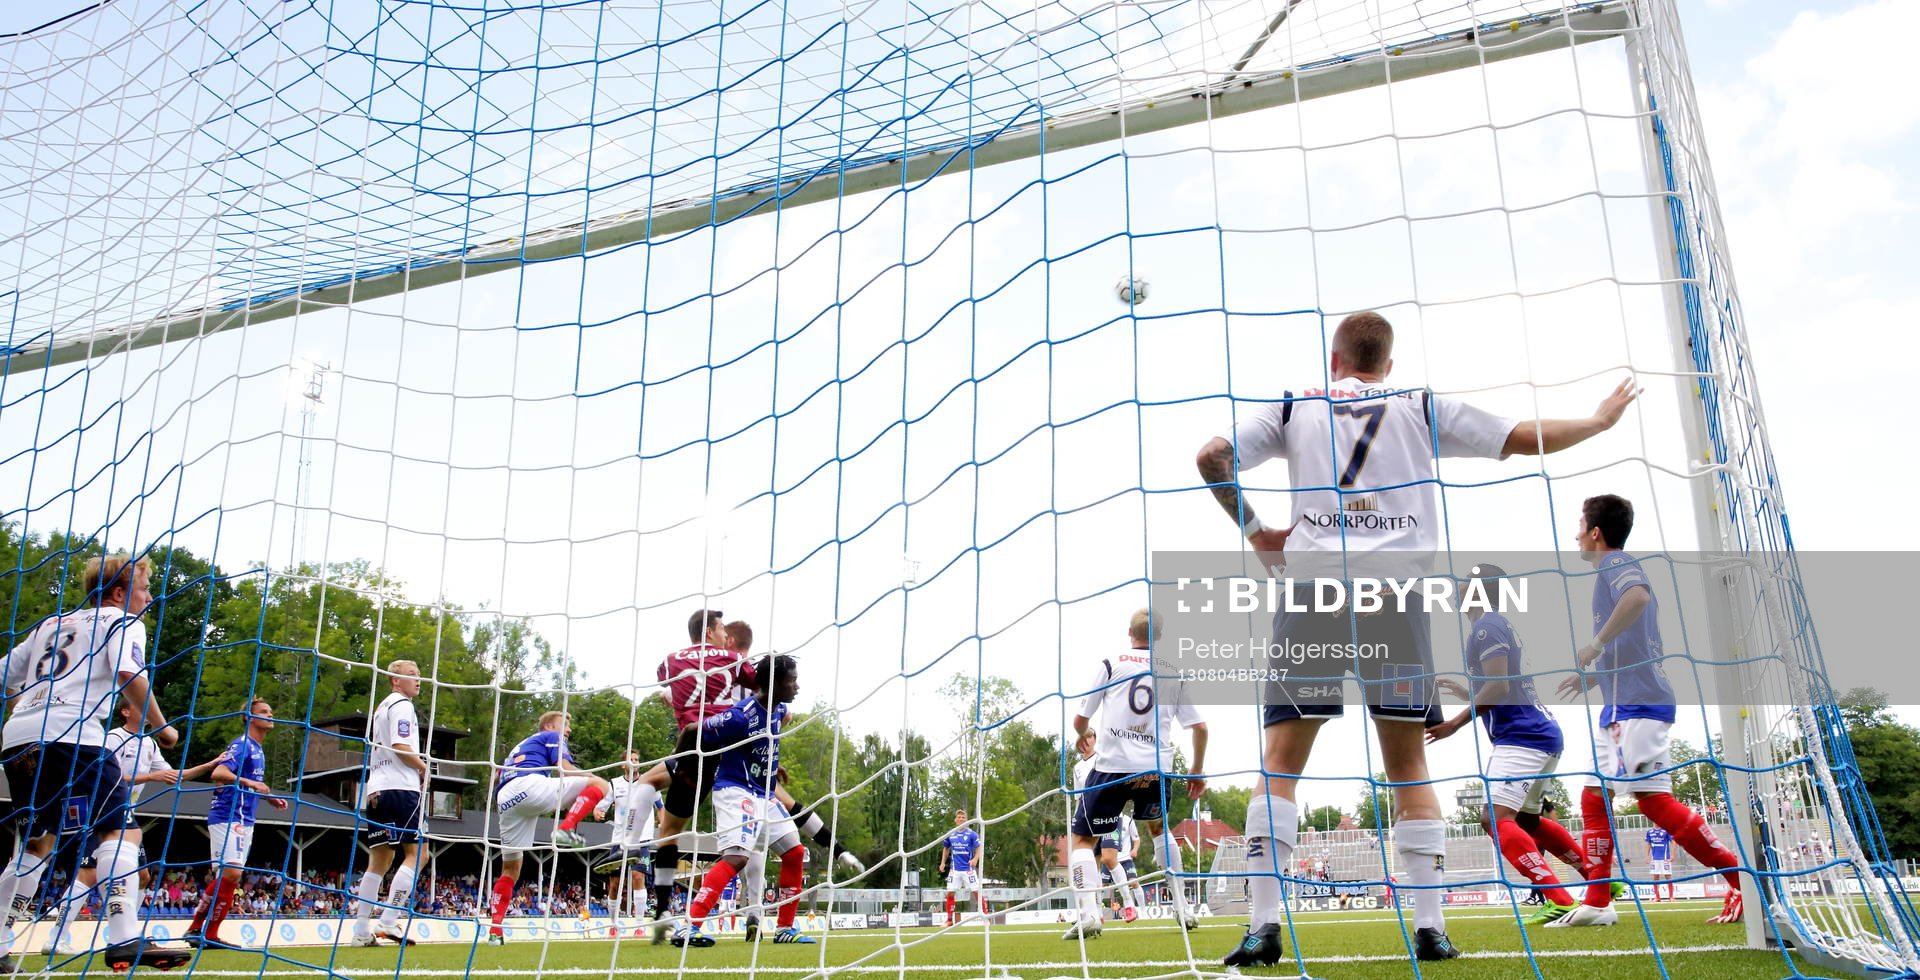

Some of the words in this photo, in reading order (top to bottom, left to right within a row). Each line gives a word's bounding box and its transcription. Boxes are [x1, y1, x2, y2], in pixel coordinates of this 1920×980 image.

[1333, 402, 1388, 487] 7
[1303, 512, 1418, 532] NORRPORTEN
[36, 627, 77, 681] 8
[674, 649, 729, 660] Canon
[683, 666, 734, 707] 22
[1128, 676, 1155, 715] 6
[1586, 838, 1596, 855] INTER
[1596, 838, 1609, 855] SPORT
